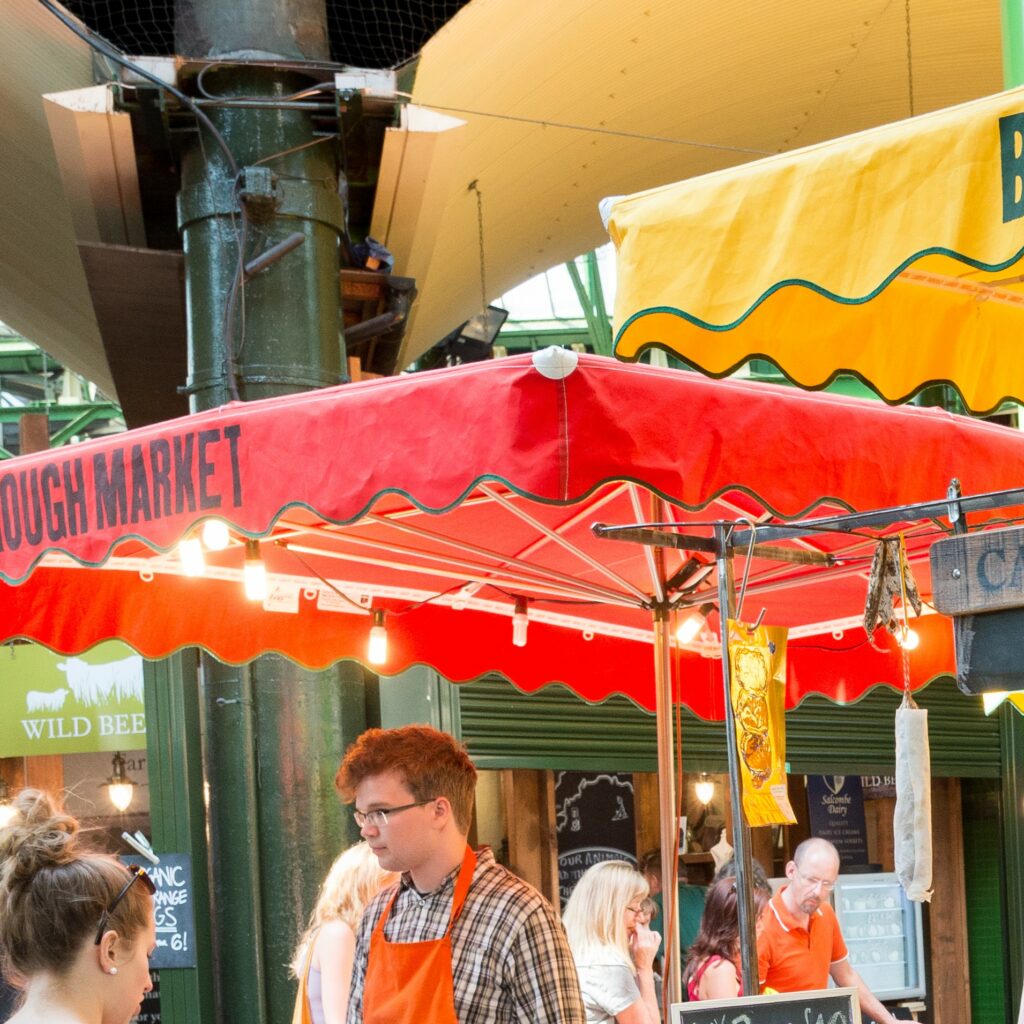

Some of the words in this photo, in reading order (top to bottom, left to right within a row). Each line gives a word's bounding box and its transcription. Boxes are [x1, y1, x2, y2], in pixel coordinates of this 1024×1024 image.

[0, 458, 88, 551] OUGH
[93, 424, 242, 530] MARKET
[21, 717, 92, 740] WILD
[98, 713, 147, 736] BEE
[827, 805, 847, 817] Dairy
[170, 931, 188, 951] 6!
